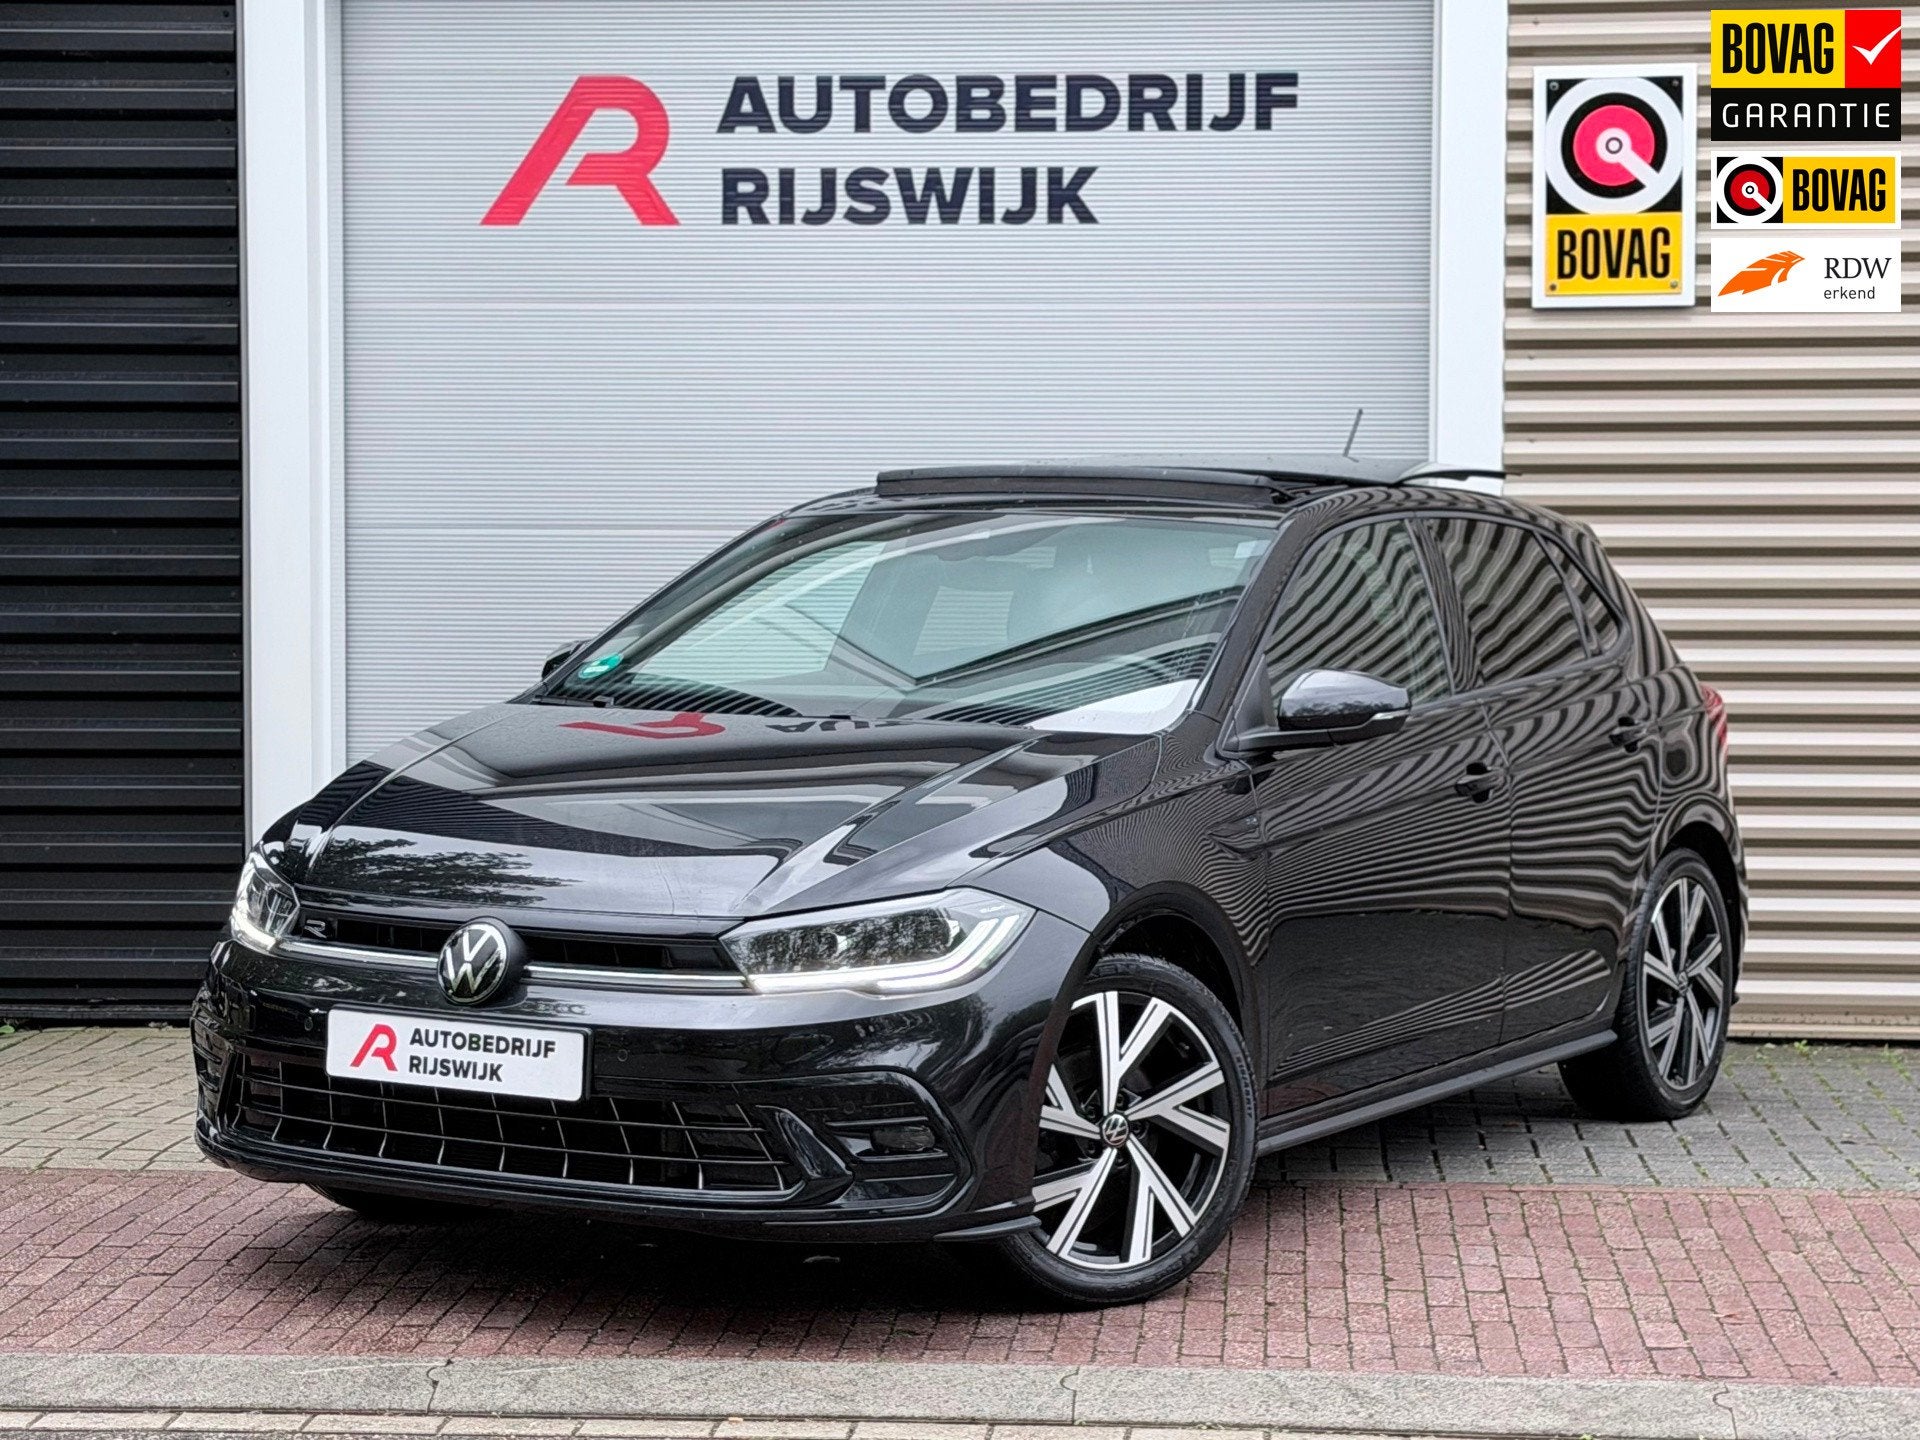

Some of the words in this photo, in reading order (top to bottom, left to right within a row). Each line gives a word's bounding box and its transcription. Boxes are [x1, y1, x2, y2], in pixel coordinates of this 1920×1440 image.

[717, 72, 1299, 134] AUTOBEDRIJF
[721, 166, 1098, 226] RIJSWIJK
[1556, 227, 1671, 281] BOVAG
[408, 1055, 504, 1083] RIJSWIJK
[409, 1027, 557, 1059] AUTOBEDRIJF
